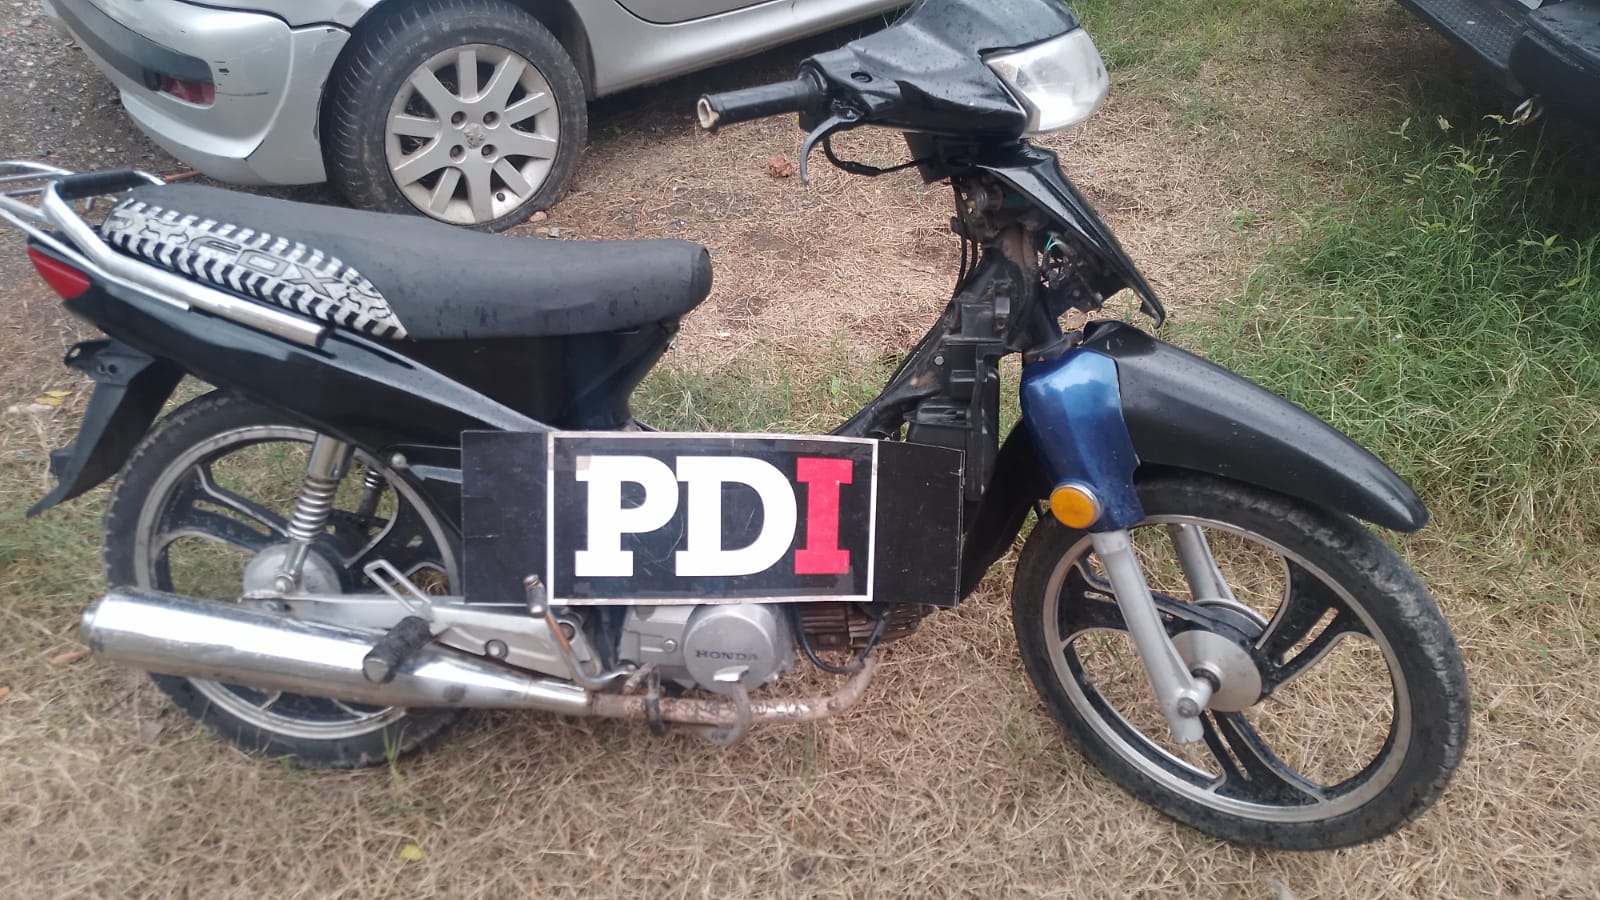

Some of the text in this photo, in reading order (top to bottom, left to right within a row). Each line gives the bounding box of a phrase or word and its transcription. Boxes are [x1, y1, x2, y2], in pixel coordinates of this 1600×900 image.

[187, 235, 344, 299] FOX
[575, 455, 853, 577] PDI
[695, 650, 758, 661] HONDA
